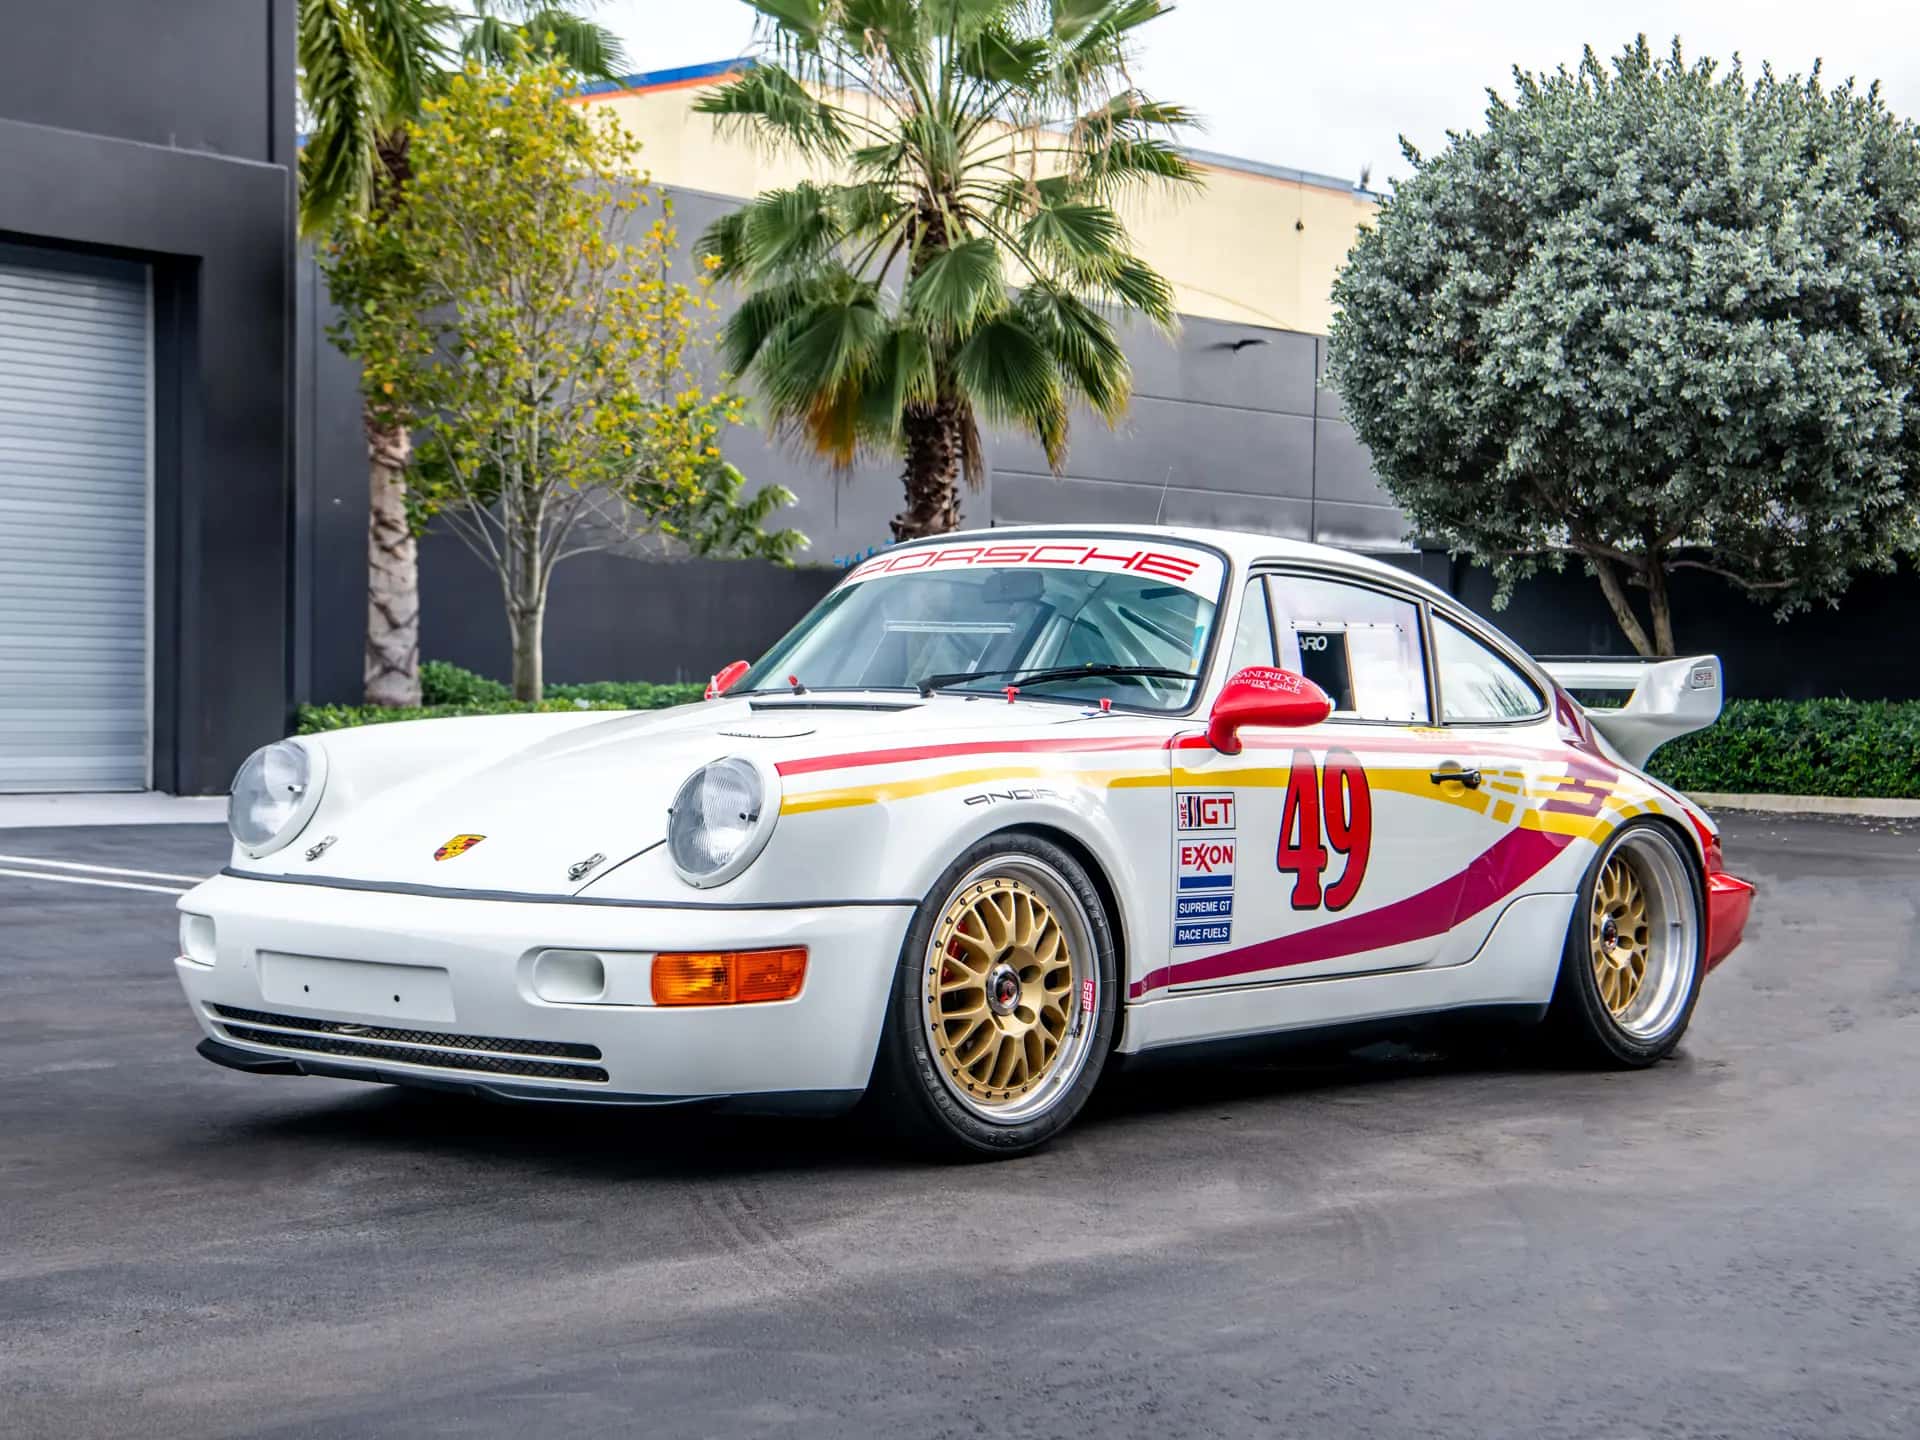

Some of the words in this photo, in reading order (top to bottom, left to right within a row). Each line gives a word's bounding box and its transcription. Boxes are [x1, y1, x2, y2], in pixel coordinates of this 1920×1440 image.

[844, 545, 1200, 582] PORSCHE
[1202, 798, 1233, 825] GT
[1276, 745, 1373, 912] 49
[1181, 843, 1233, 872] EXXON
[1178, 901, 1218, 914] SUPREME
[1219, 900, 1231, 911] GT
[1178, 929, 1201, 941] RACE
[1202, 927, 1228, 940] FUELS
[1083, 981, 1093, 1010] BBS
